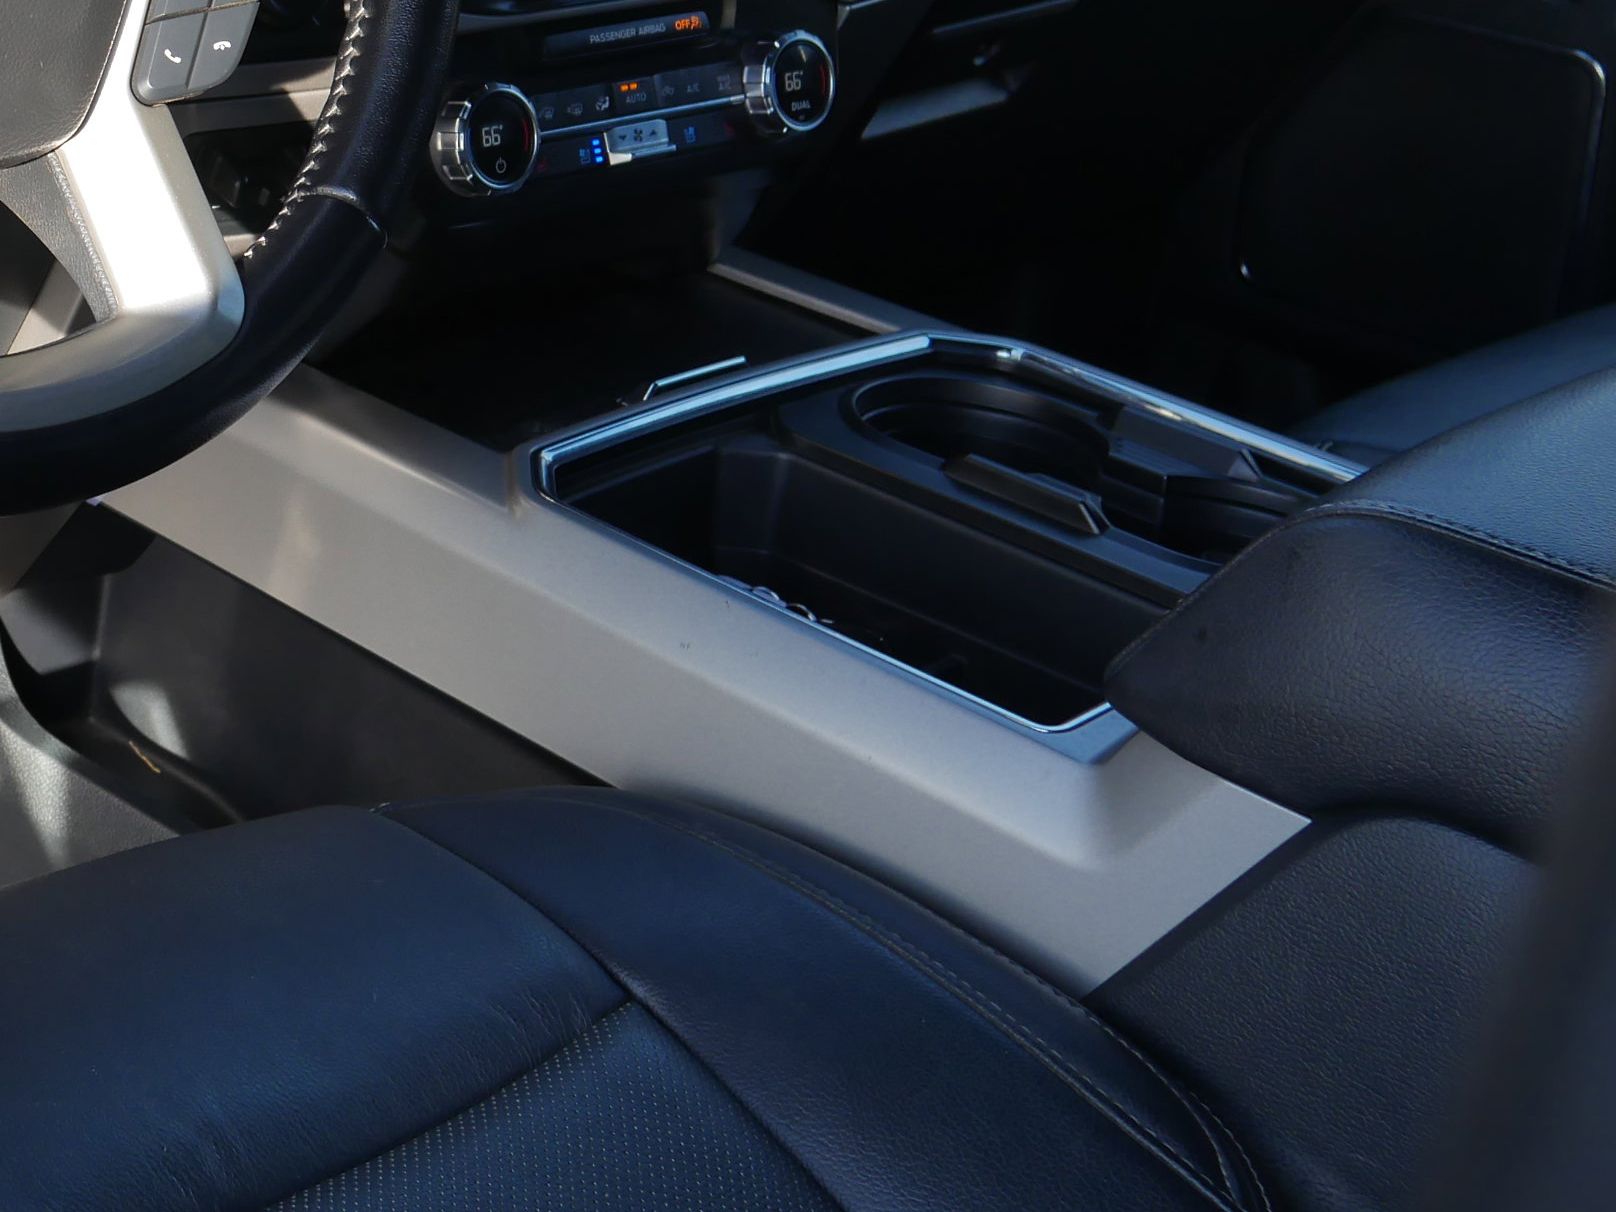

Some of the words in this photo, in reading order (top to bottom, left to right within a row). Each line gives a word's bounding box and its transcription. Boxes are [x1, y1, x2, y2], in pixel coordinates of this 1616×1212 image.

[675, 18, 691, 31] OFF
[589, 27, 636, 44] PASSENGER
[638, 23, 666, 36] AIRBAG
[625, 92, 647, 104] AUTO
[791, 100, 811, 111] DUAL
